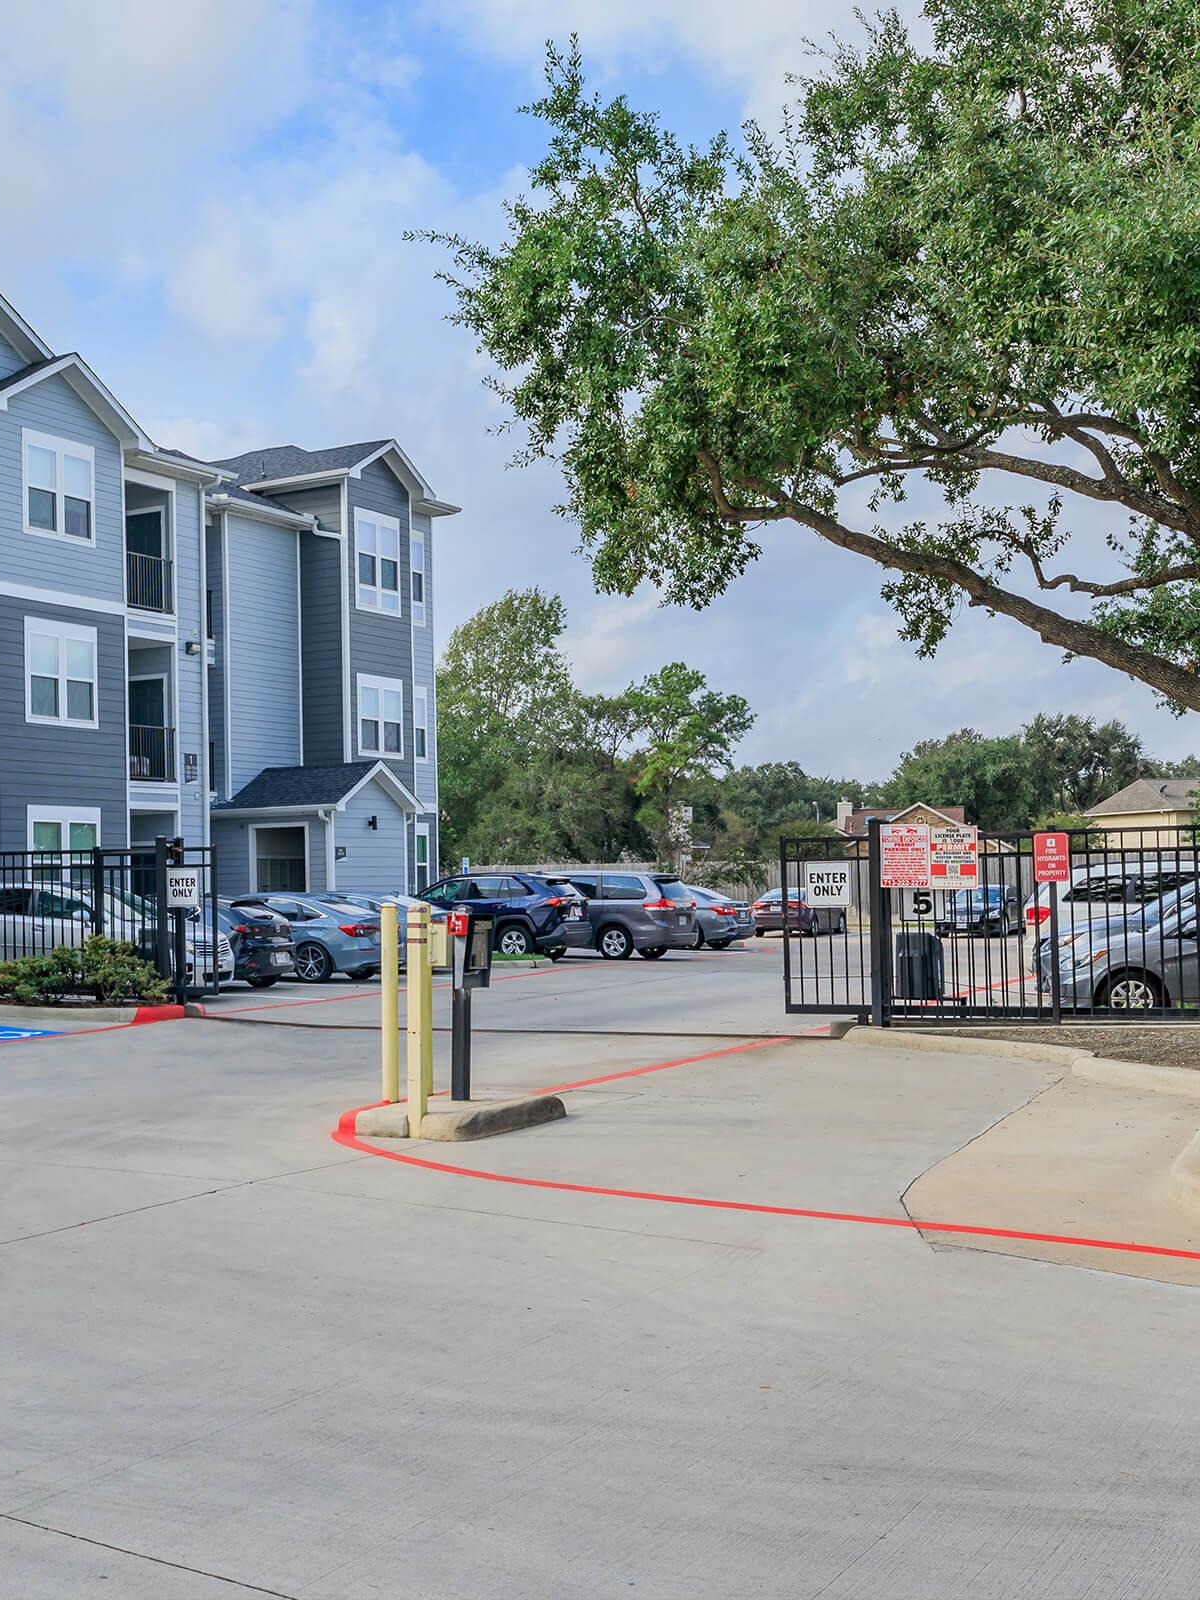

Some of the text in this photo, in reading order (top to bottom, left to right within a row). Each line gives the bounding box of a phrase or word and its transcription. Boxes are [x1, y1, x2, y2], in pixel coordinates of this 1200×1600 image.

[170, 878, 196, 887] ENTER
[809, 873, 847, 883] ENTER
[172, 888, 193, 897] ONLY
[814, 885, 843, 896] ONLY
[913, 892, 932, 915] 5
